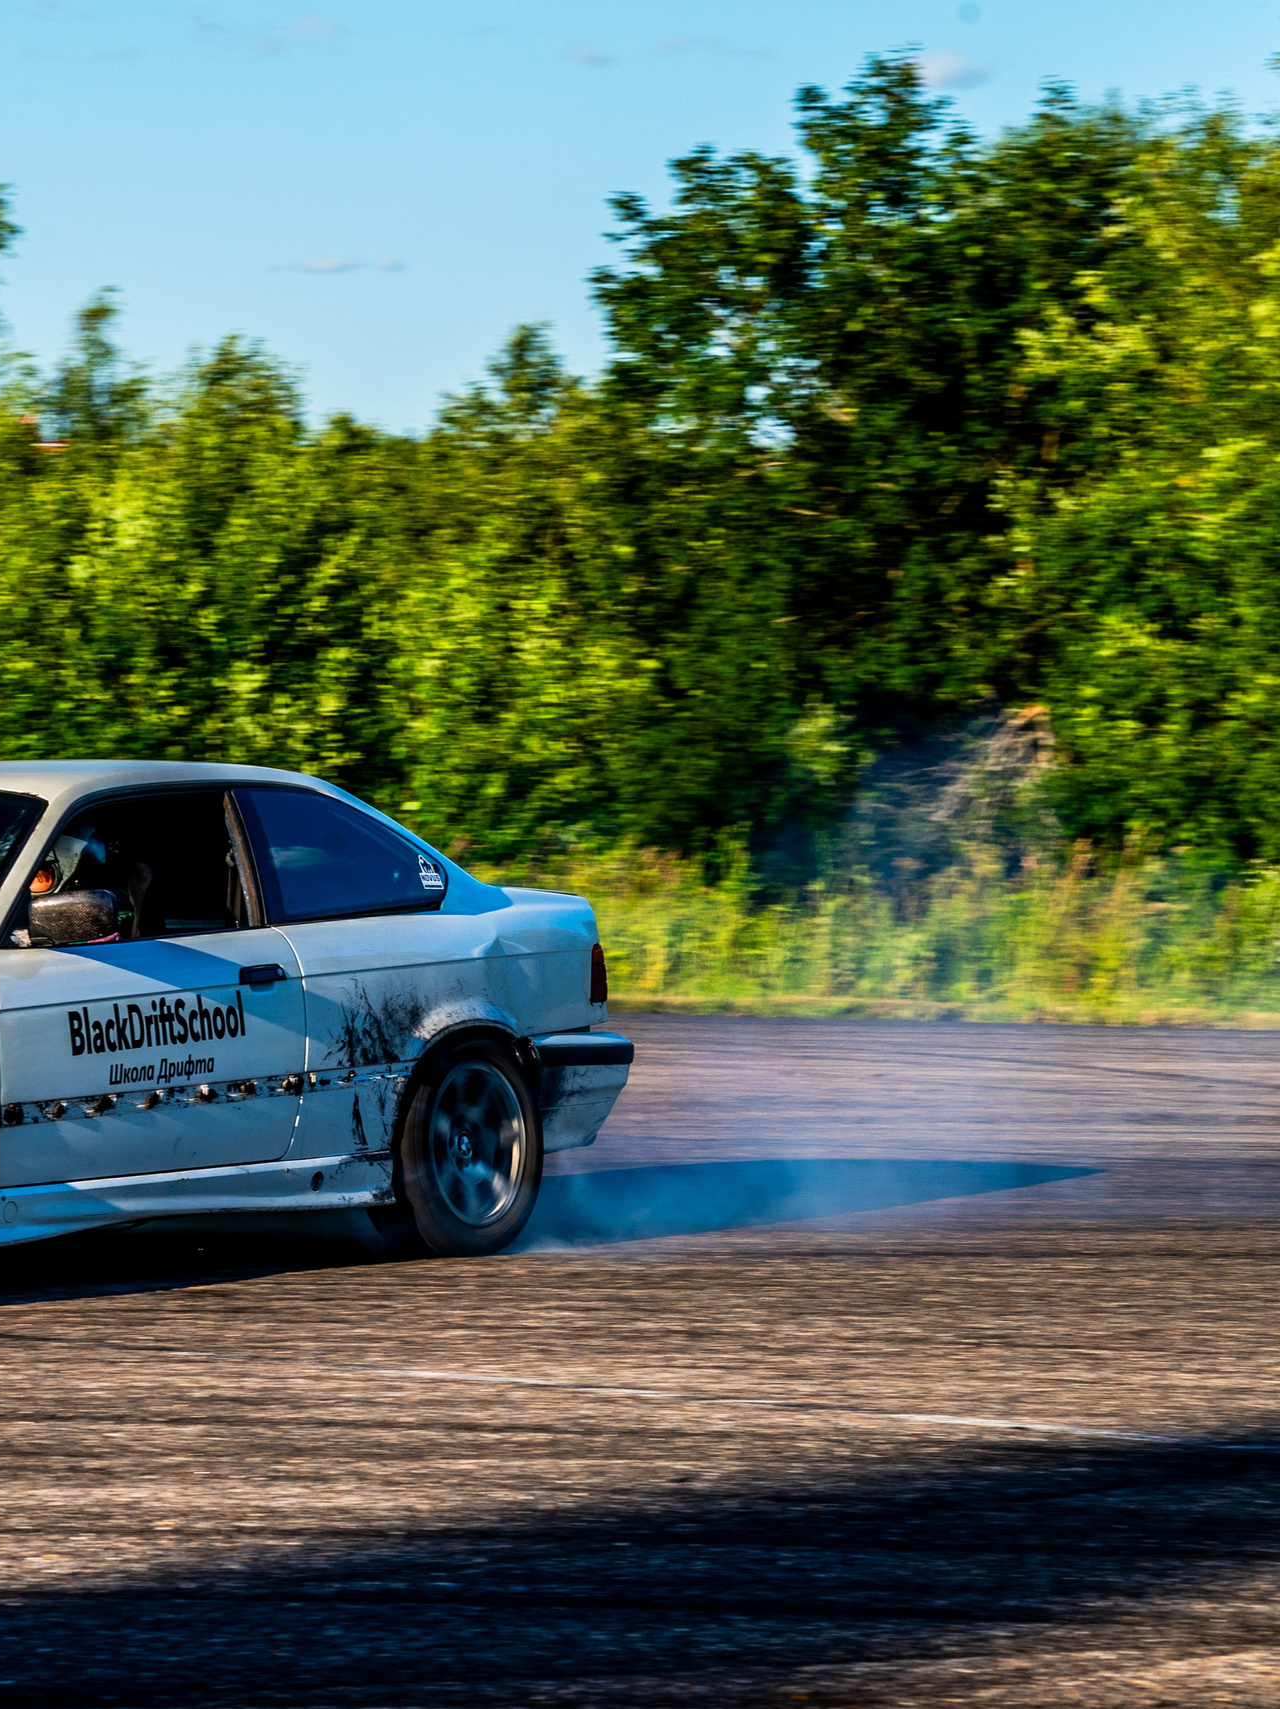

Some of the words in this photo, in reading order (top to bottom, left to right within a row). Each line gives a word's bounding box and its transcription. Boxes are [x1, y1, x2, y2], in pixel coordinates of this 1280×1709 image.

[68, 990, 246, 1056] BlackDriftSchool
[109, 1063, 155, 1085] Школа
[157, 1054, 215, 1084] Дрифта
